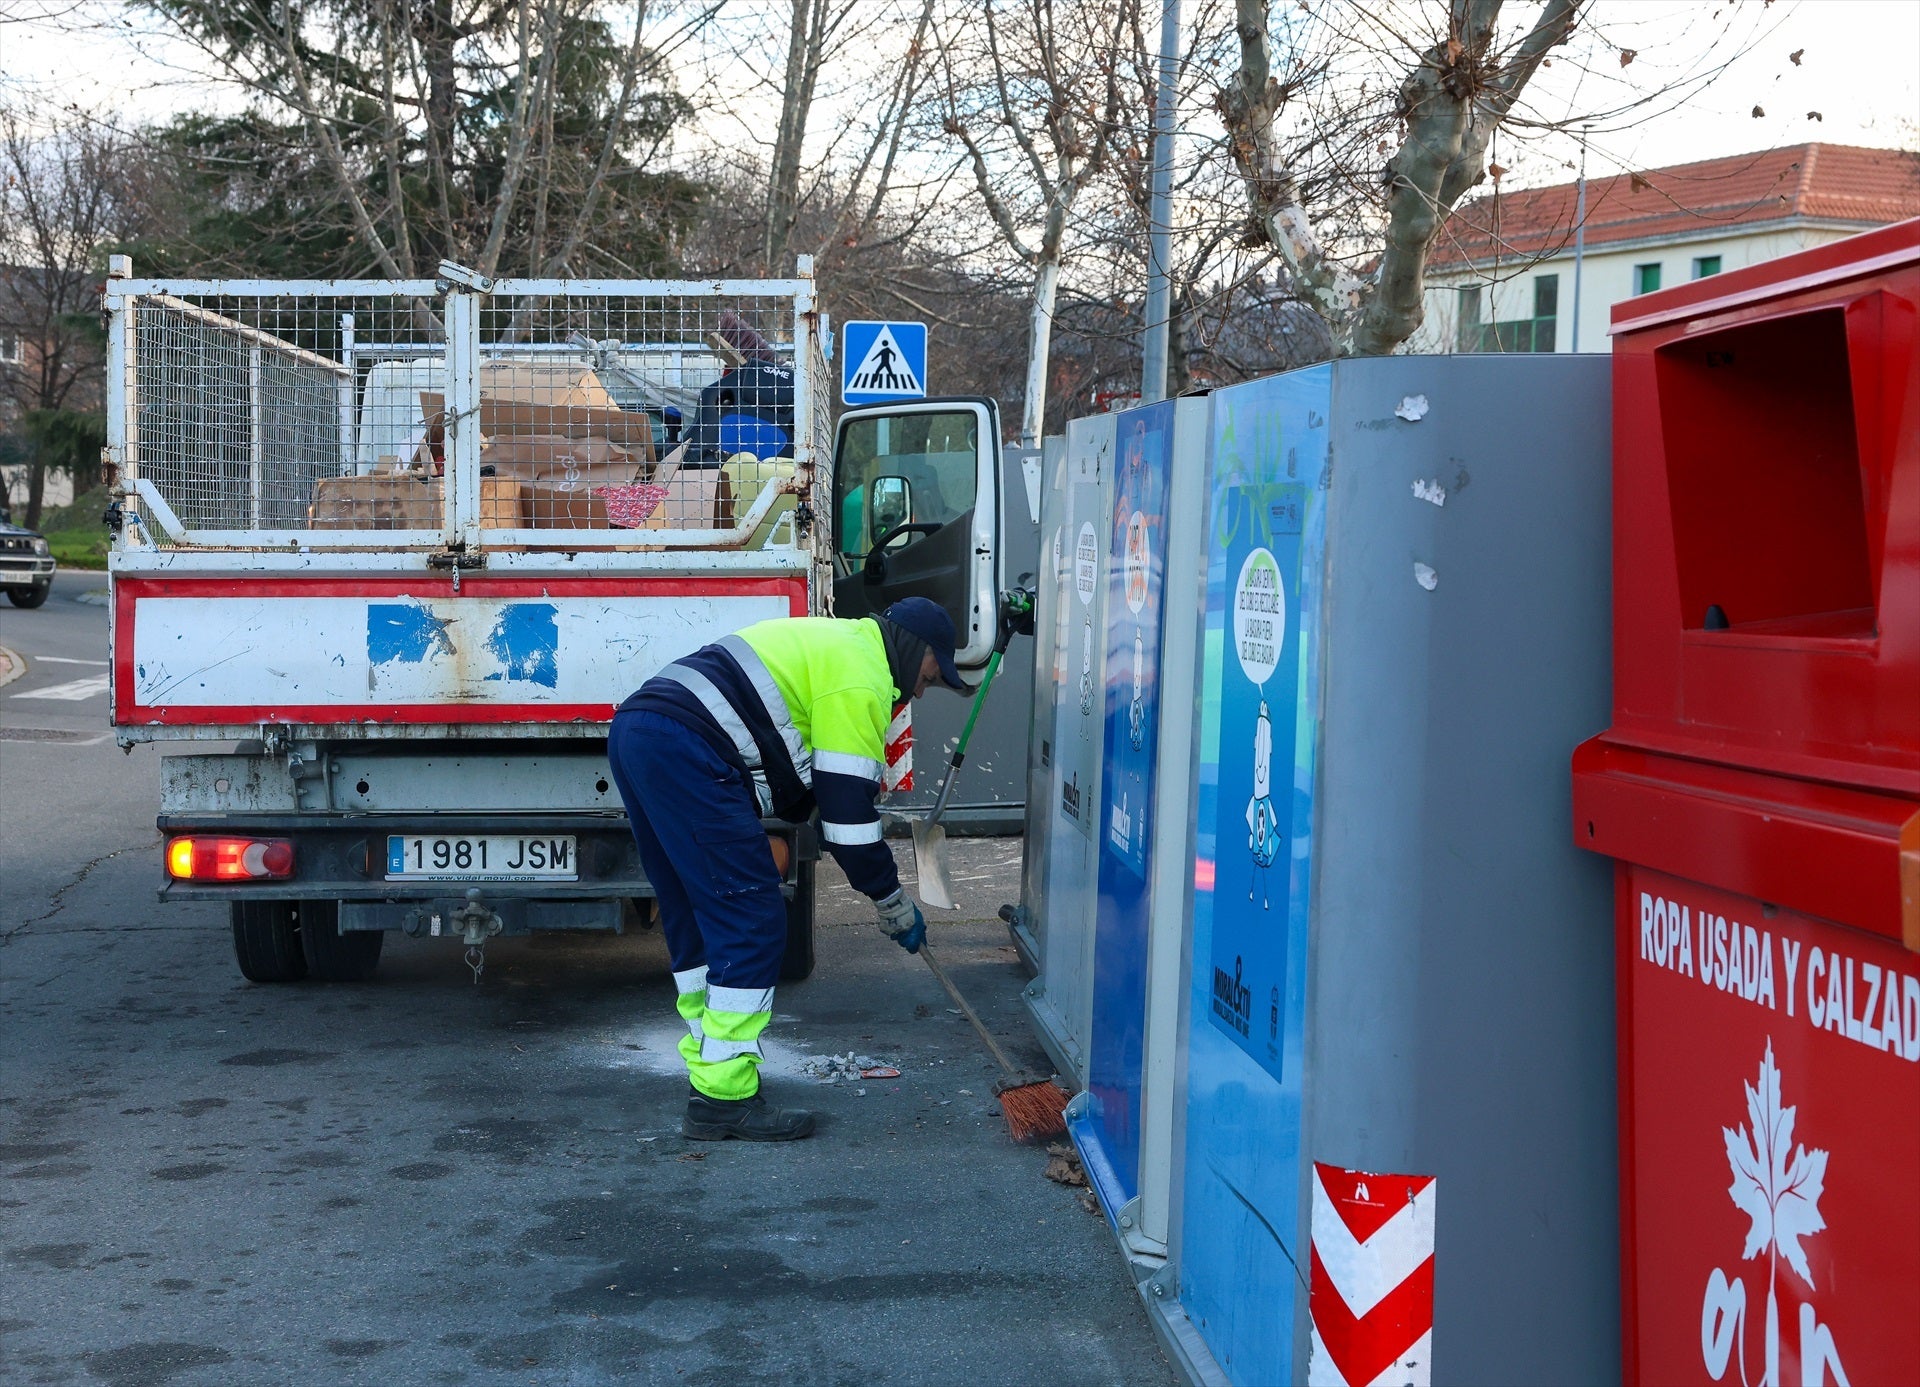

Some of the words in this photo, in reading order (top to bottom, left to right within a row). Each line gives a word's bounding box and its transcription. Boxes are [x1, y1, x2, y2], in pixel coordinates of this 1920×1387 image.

[763, 366, 790, 380] GAME
[392, 859, 400, 867] E
[414, 840, 487, 869] 1981
[507, 840, 568, 869] JSM
[1641, 892, 1693, 978] ROPA
[1699, 910, 1775, 1010] USADA
[1782, 937, 1800, 1017] Y
[1807, 946, 1920, 1062] CALZAD
